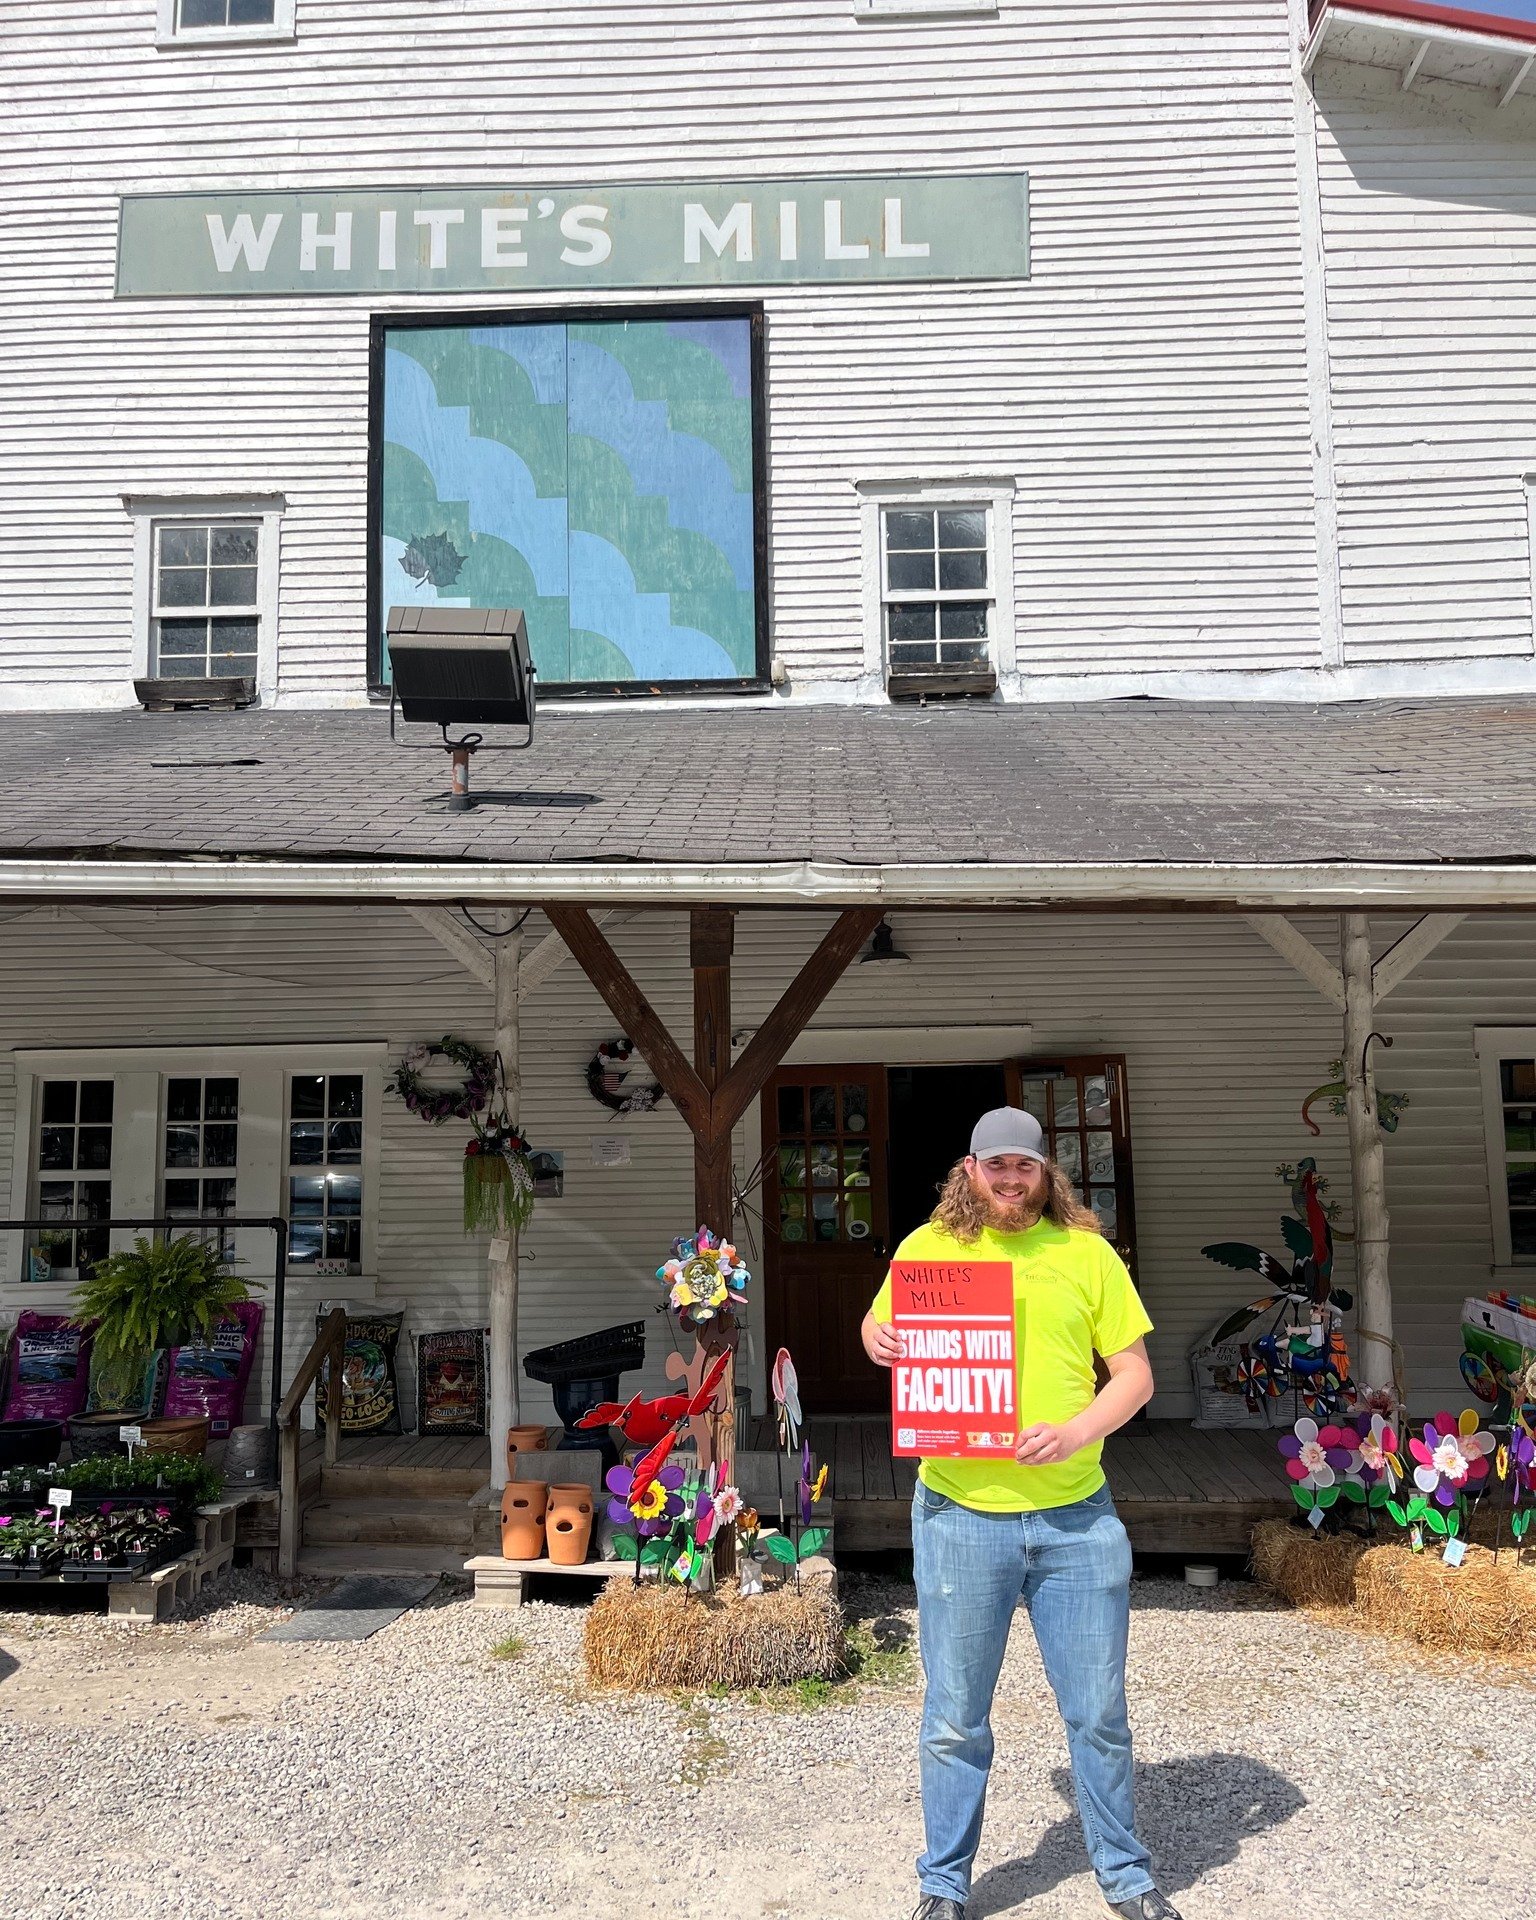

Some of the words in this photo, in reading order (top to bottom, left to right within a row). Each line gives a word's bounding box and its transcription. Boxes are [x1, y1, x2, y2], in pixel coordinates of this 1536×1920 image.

[205, 198, 613, 273] WHITE'S
[684, 198, 931, 264] MILL
[900, 1267, 973, 1284] WHITE'S
[911, 1291, 965, 1308] MILL
[897, 1329, 962, 1359] STANDS
[964, 1329, 1012, 1360] WITH
[897, 1366, 1014, 1414] FACULTY!
